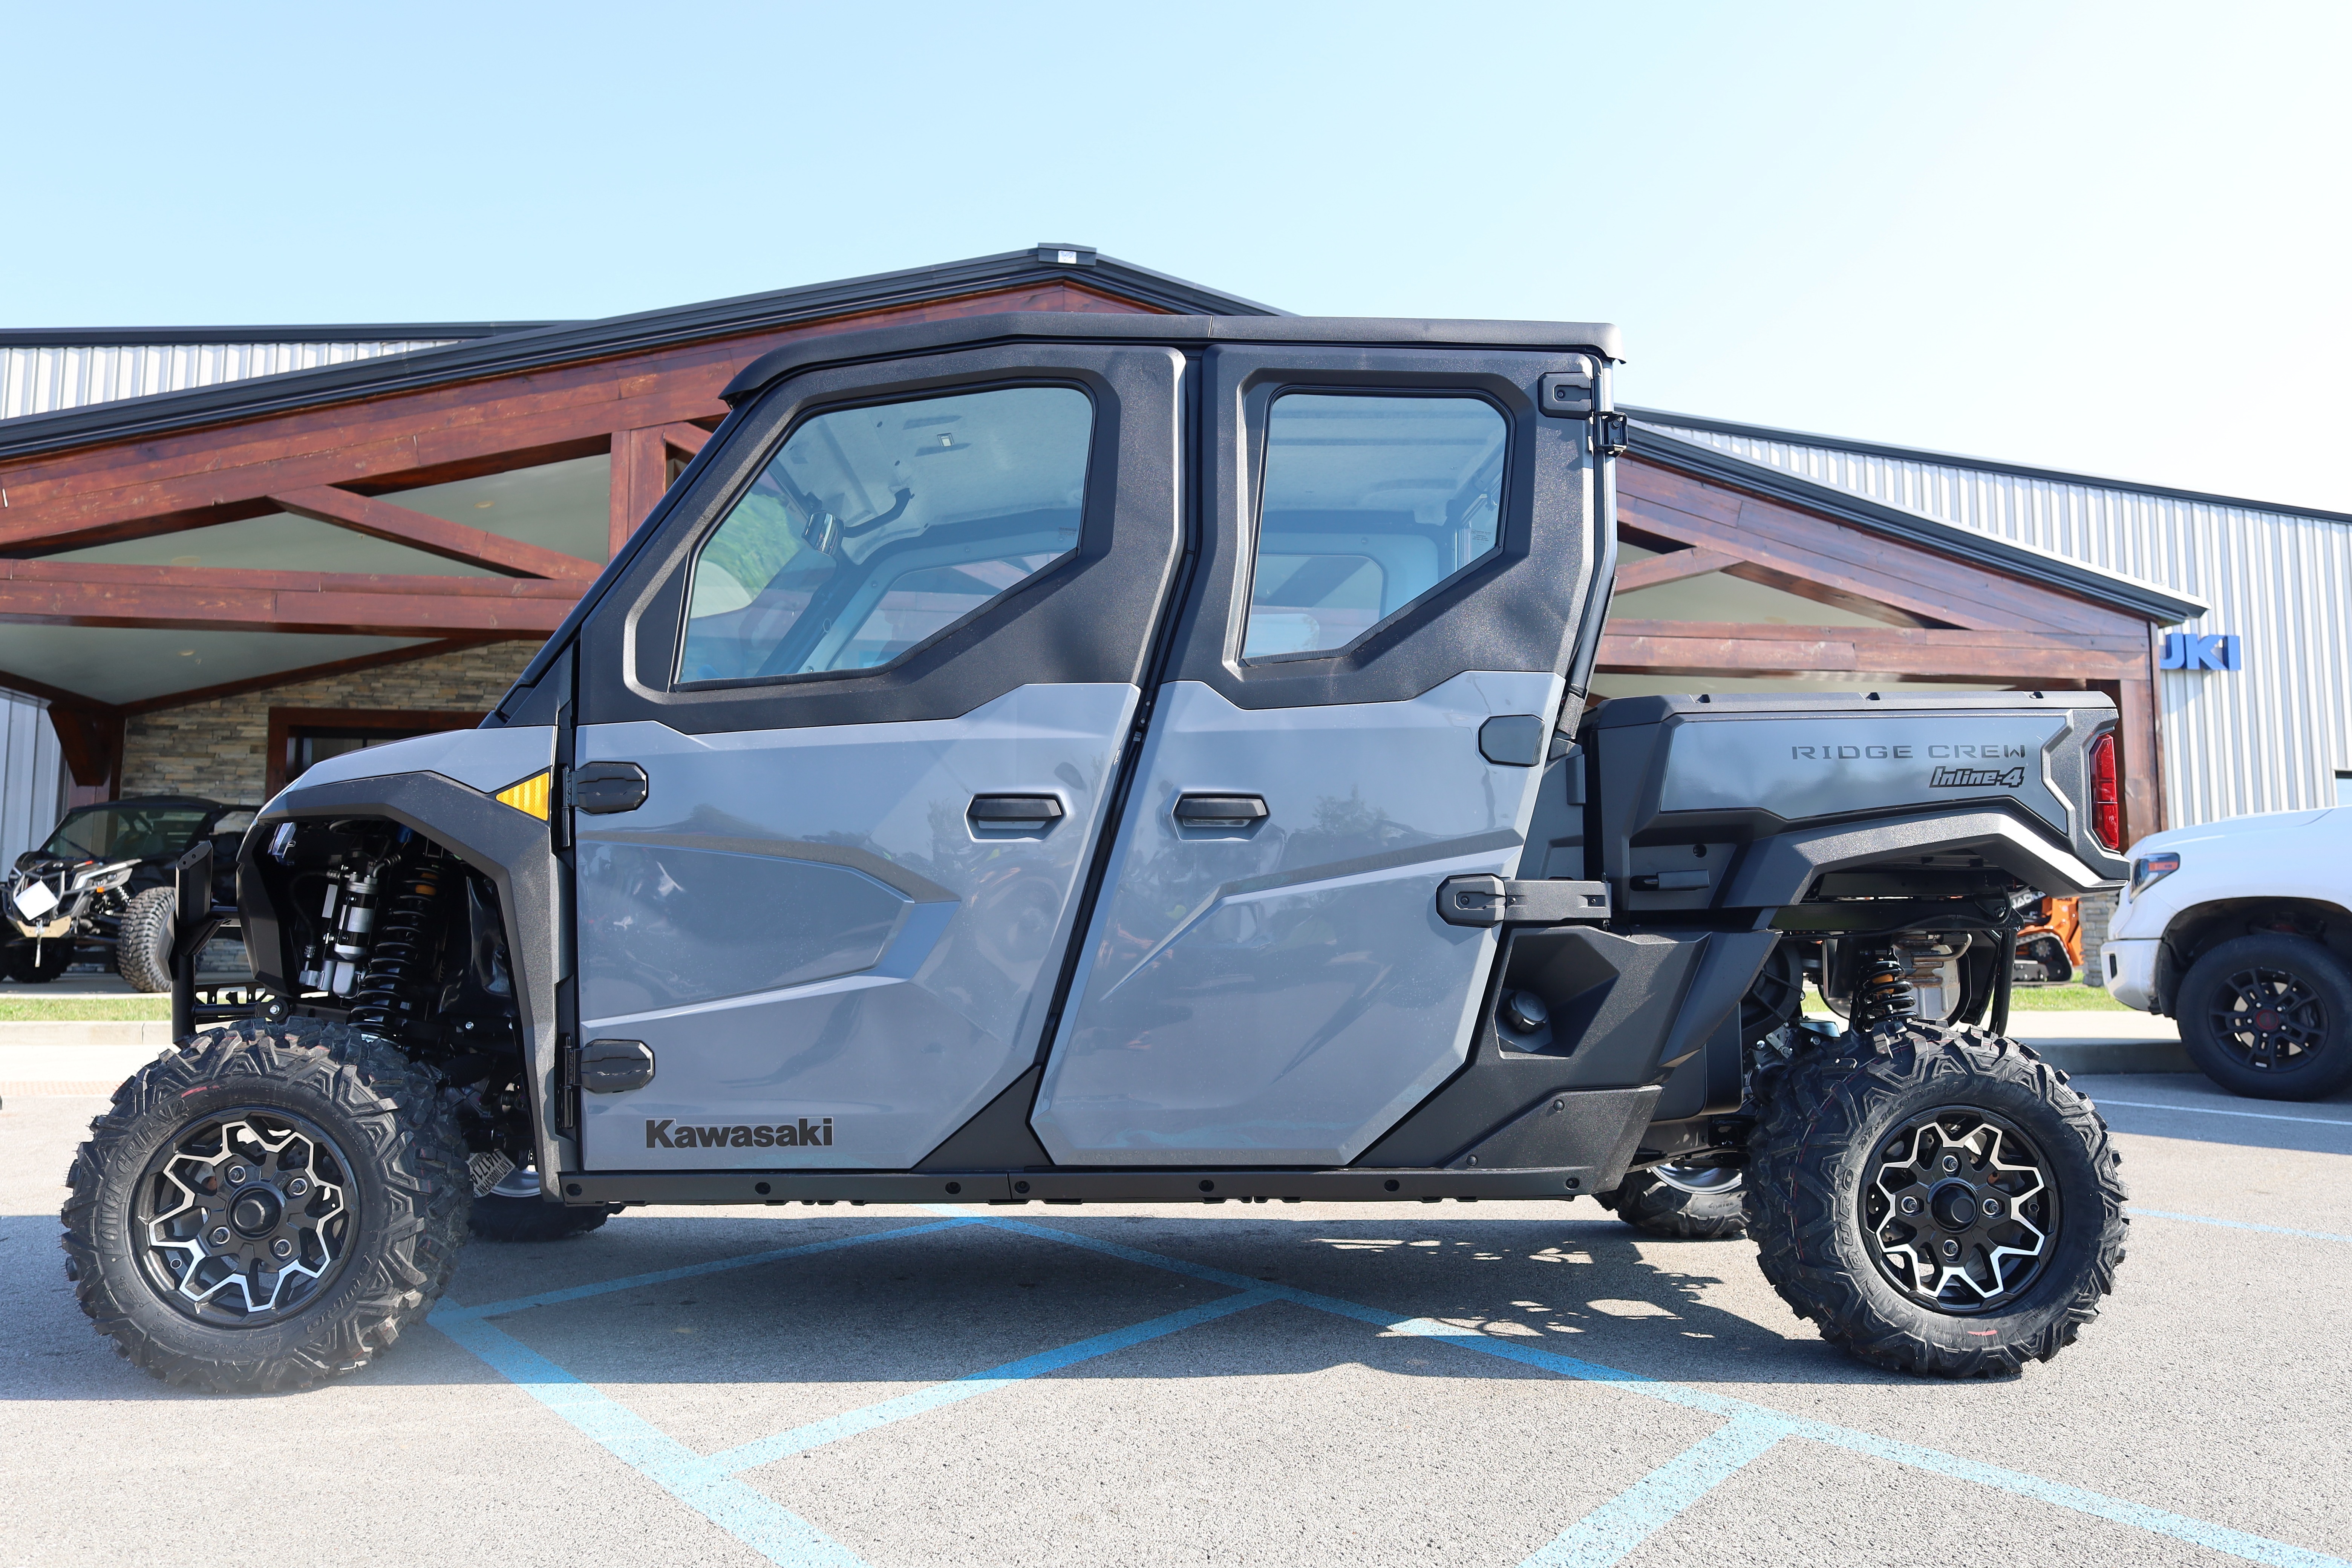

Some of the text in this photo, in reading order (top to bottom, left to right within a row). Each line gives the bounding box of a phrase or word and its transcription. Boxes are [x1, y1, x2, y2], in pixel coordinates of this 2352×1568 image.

[1792, 745, 2025, 760] RIDGE CREW
[1929, 766, 2024, 788] Inline-4
[646, 1118, 832, 1148] Kawasaki
[101, 1098, 186, 1256] POWER GRIP V2
[1839, 1169, 1865, 1270] DURO
